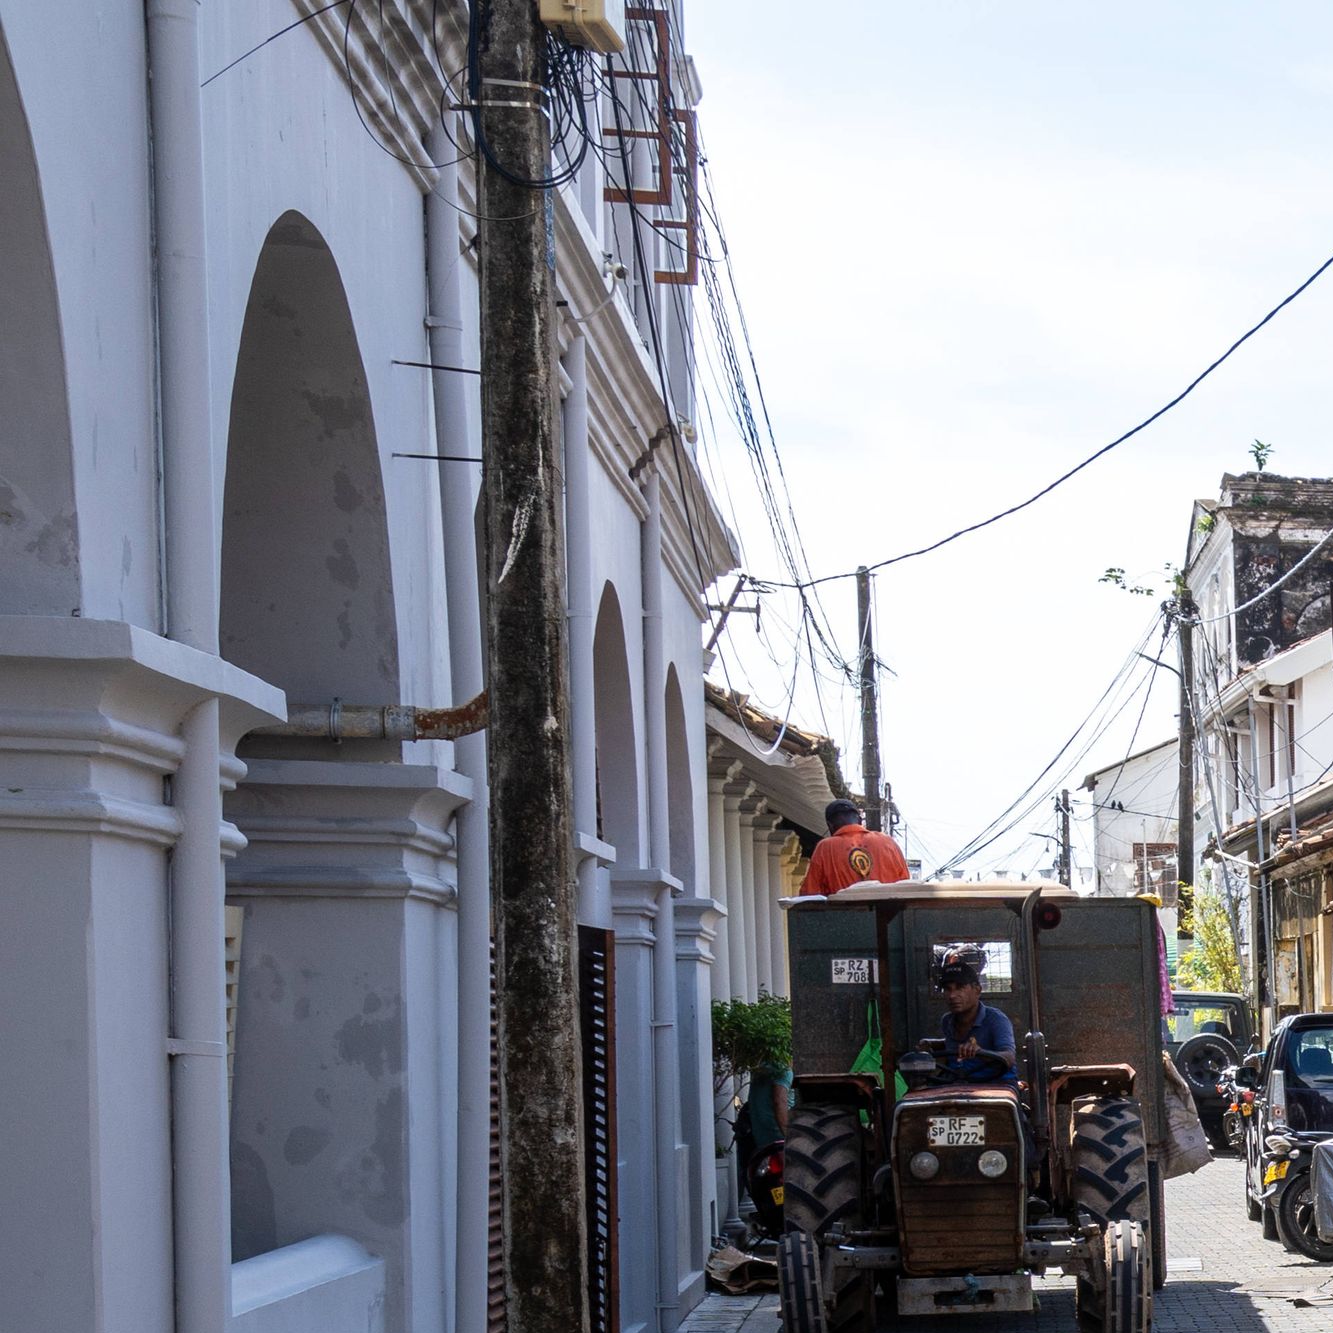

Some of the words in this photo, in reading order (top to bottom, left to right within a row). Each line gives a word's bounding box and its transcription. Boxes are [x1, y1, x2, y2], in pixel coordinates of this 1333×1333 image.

[833, 967, 846, 976] SP
[931, 1126, 946, 1137] SP
[947, 1132, 979, 1145] 0722
